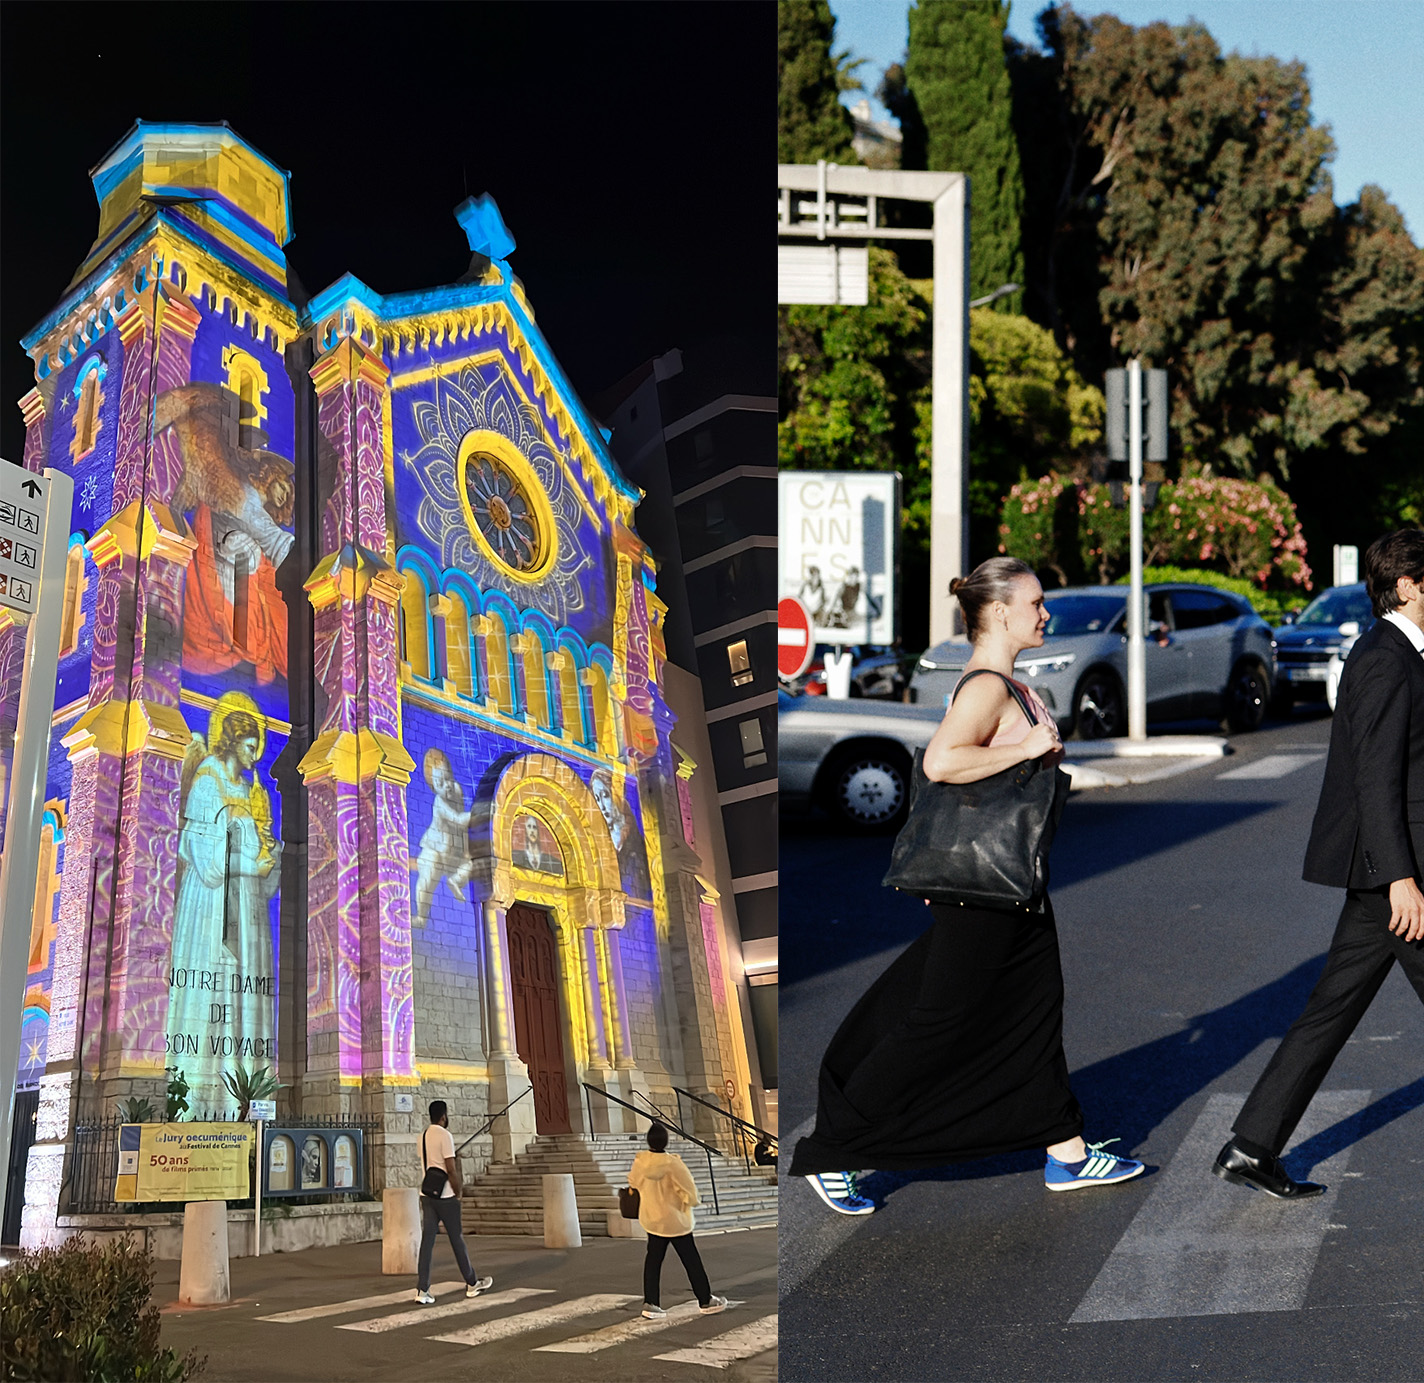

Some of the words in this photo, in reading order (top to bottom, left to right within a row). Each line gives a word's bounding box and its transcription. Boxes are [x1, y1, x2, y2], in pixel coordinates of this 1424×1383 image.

[799, 480, 852, 510] CA
[801, 517, 852, 545] NN
[230, 973, 277, 996] DAME
[209, 1003, 233, 1024] DE
[210, 1035, 277, 1059] VOYAGE
[163, 1133, 183, 1144] Jury
[186, 1132, 248, 1143] oecuménique
[150, 1155, 168, 1167] 50
[169, 1156, 189, 1165] ans
